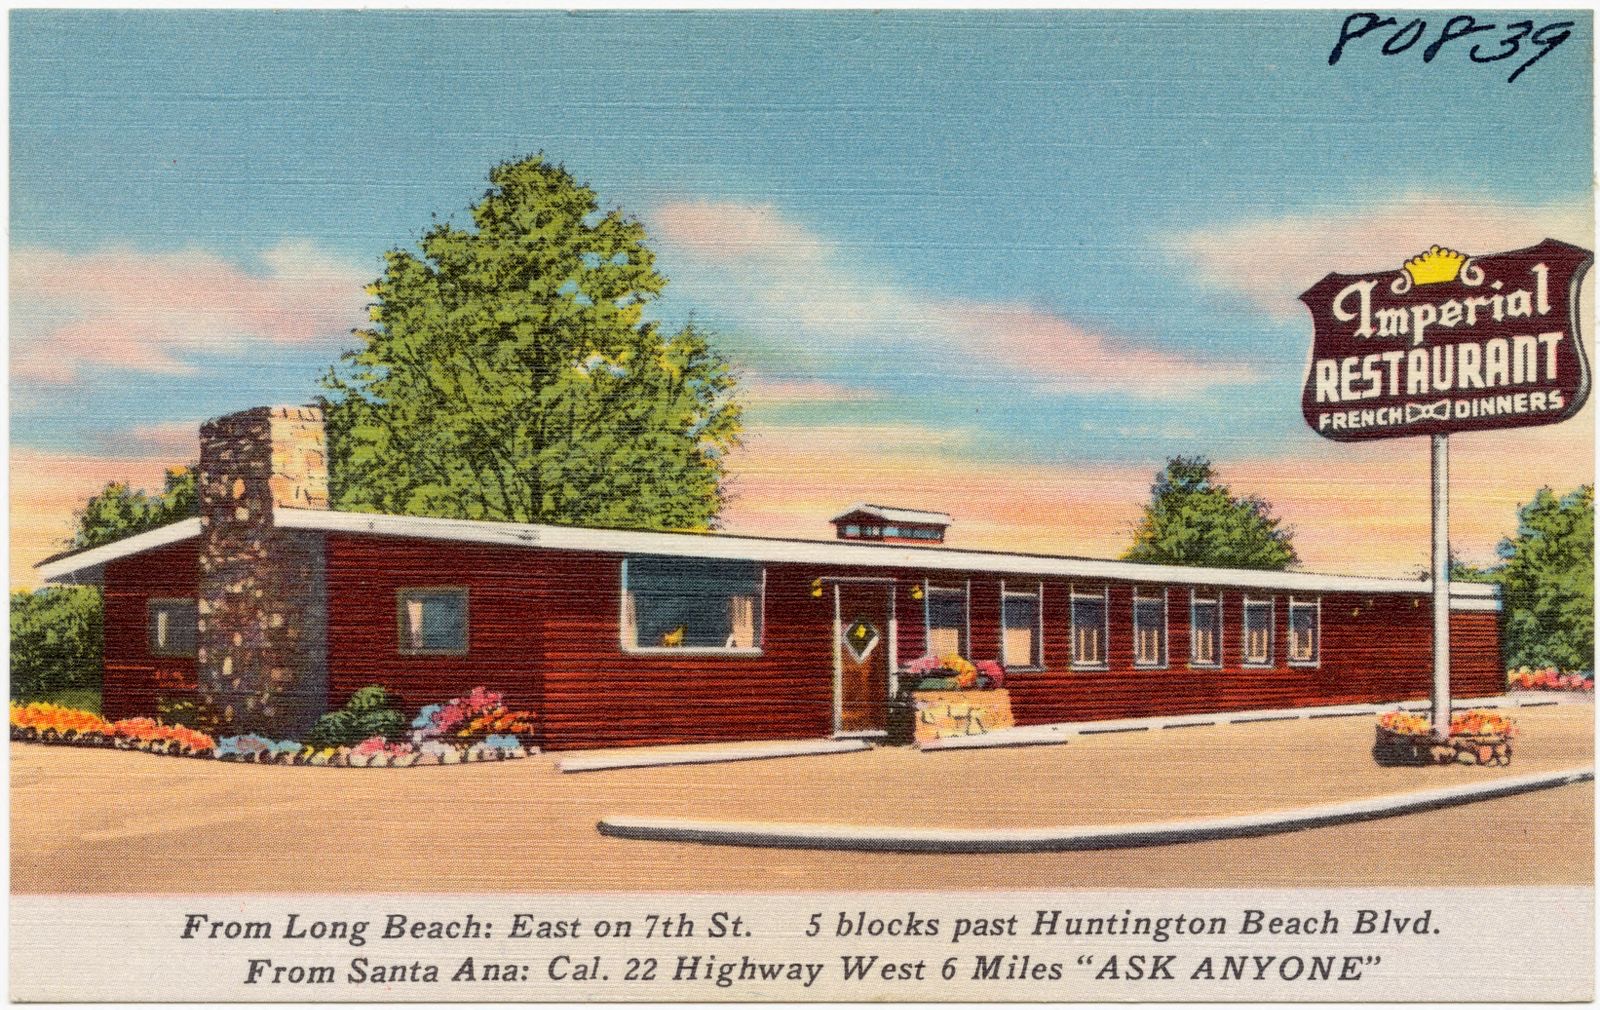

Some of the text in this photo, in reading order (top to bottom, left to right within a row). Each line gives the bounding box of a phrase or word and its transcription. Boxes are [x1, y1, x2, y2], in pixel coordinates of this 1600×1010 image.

[1332, 262, 1551, 345] Imperial
[1315, 331, 1564, 403] RESTAURANT
[1318, 389, 1564, 431] FRENCH DINNERS
[181, 910, 1440, 946] From Long Beach: East on 7th St. 5 blocks past Huntington Beach Blvd.
[244, 959, 335, 983] From
[347, 958, 439, 983] Santa
[452, 957, 530, 982] Ana:
[548, 956, 609, 981] Cal.
[625, 959, 657, 980] 22
[673, 956, 823, 988] Highway
[841, 956, 925, 981] West
[942, 958, 957, 980] 6
[971, 956, 1063, 980] Miles
